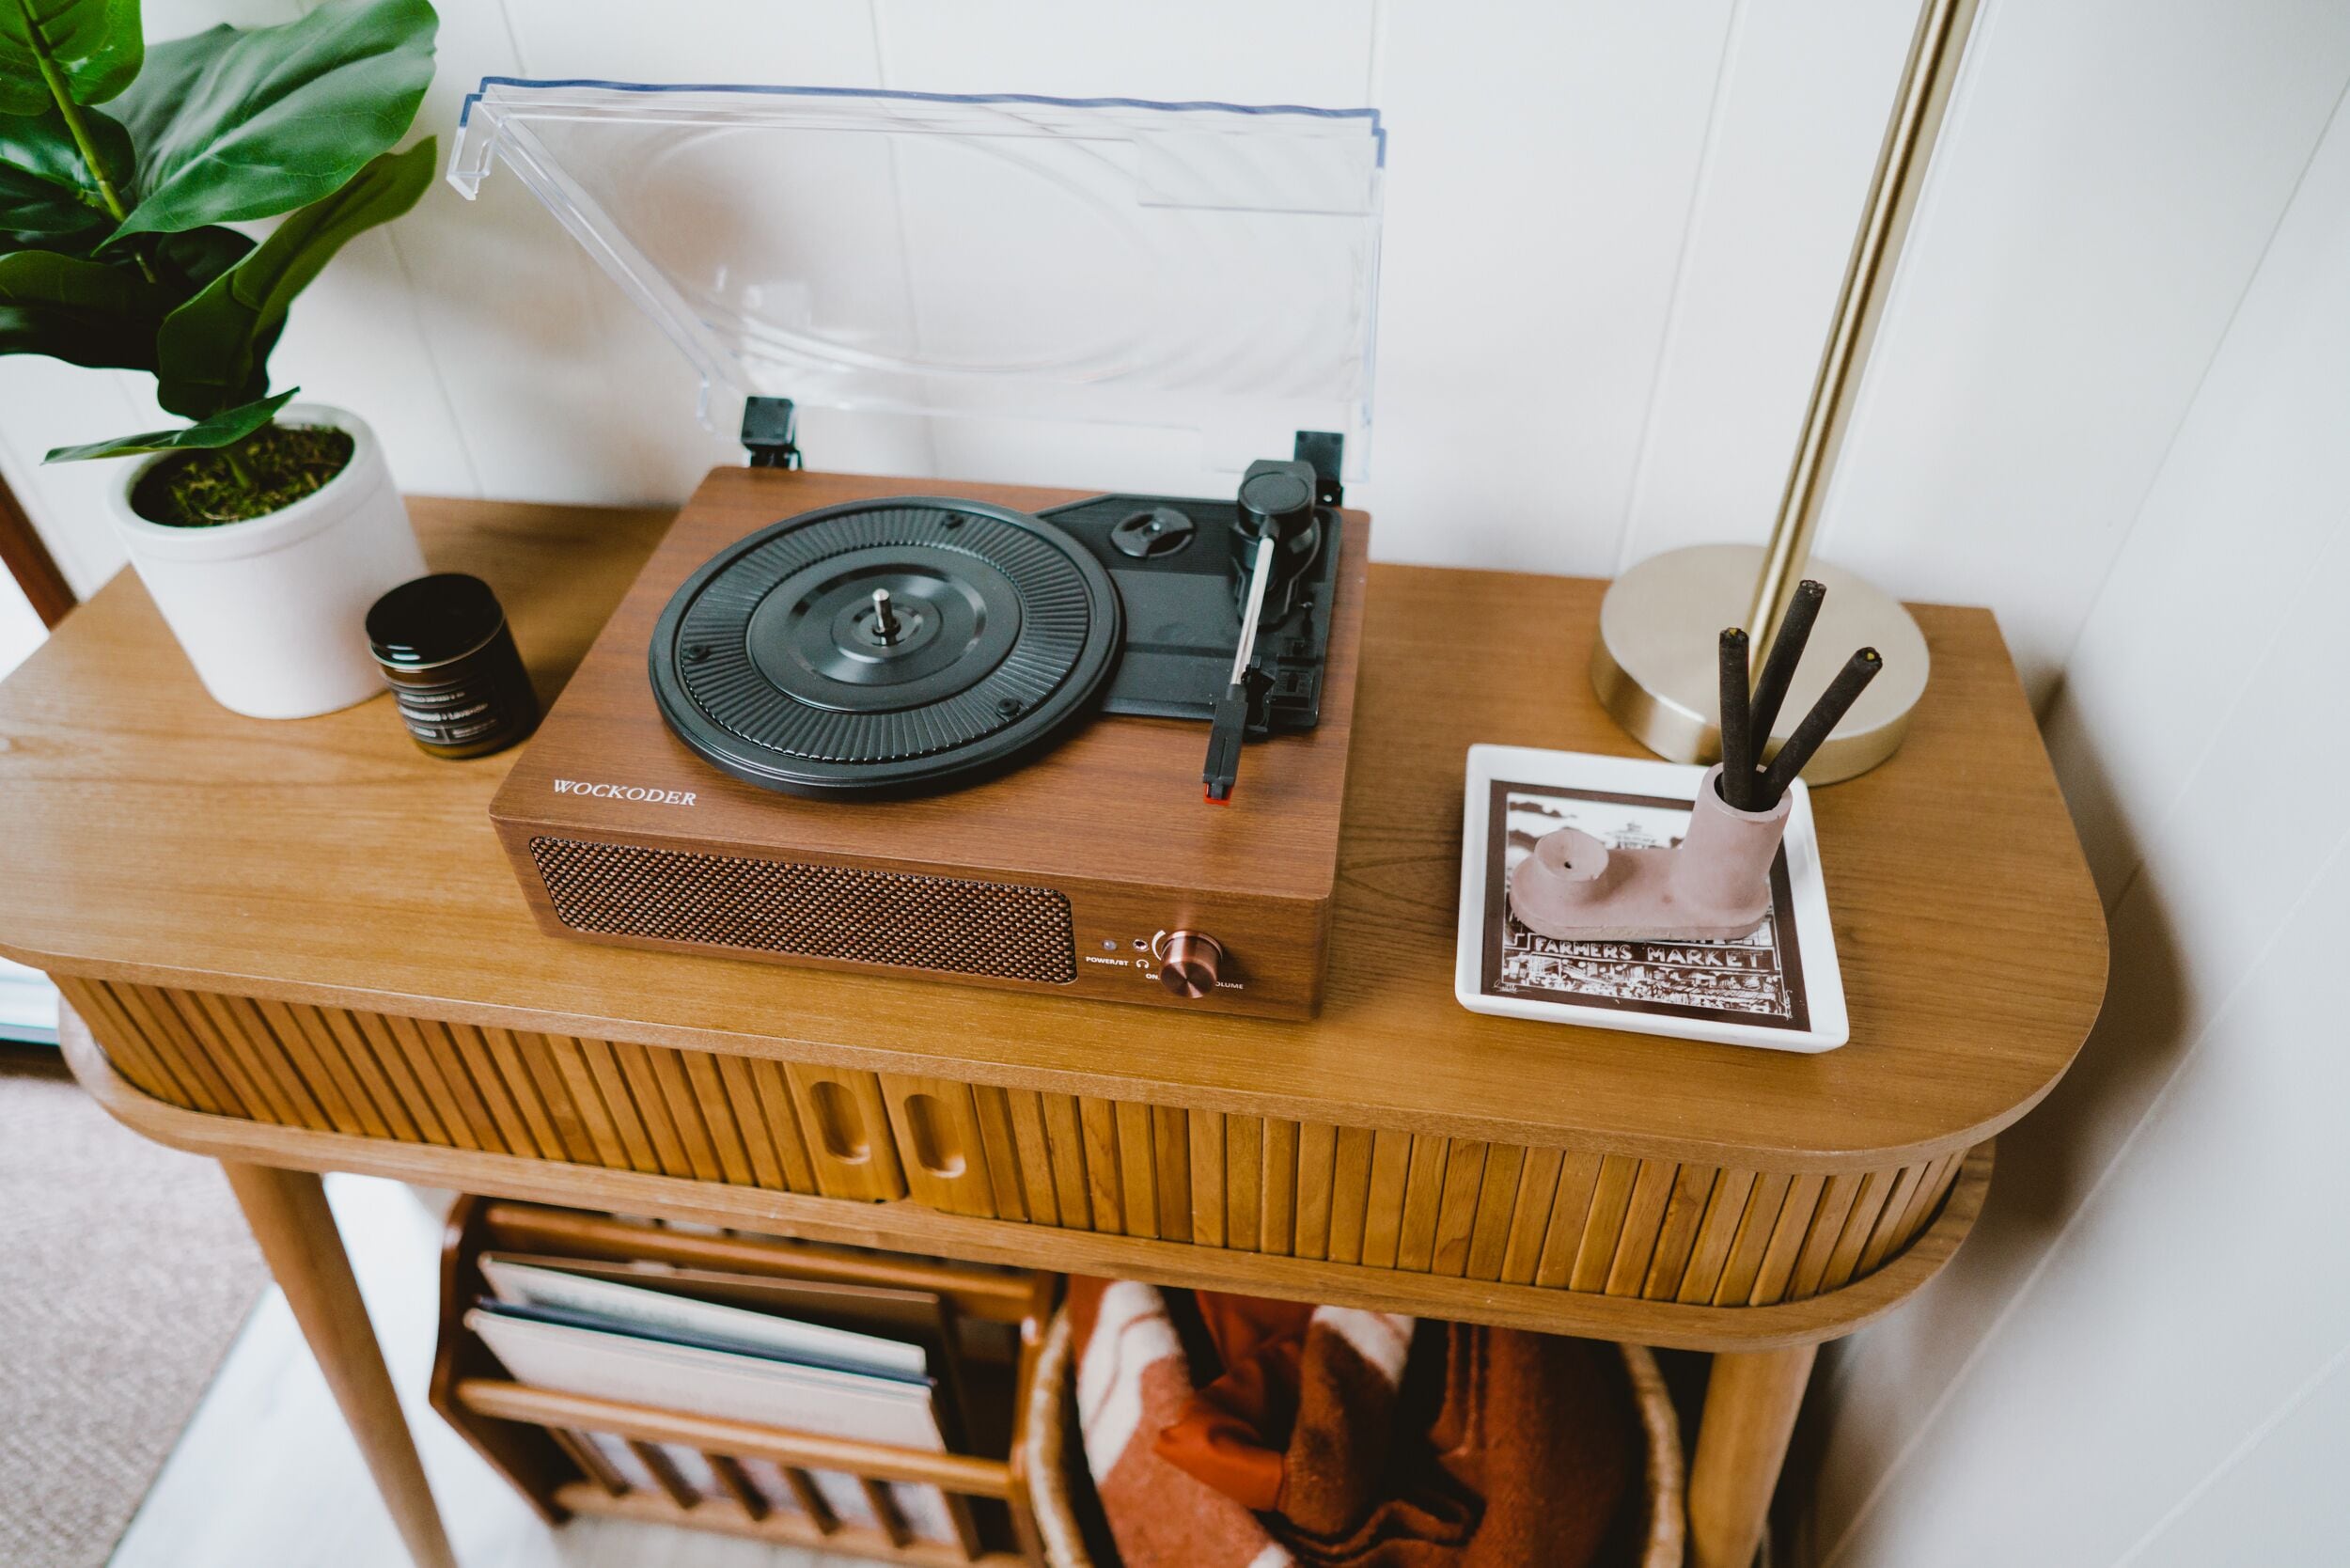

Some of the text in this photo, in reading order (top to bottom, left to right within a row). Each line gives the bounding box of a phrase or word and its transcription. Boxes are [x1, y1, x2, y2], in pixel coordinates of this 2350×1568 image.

[554, 778, 697, 807] WOCKODER
[1085, 956, 1129, 967] POWER/BT
[1535, 936, 1763, 968] FARMERS MARKET
[1215, 980, 1244, 990] OLUME
